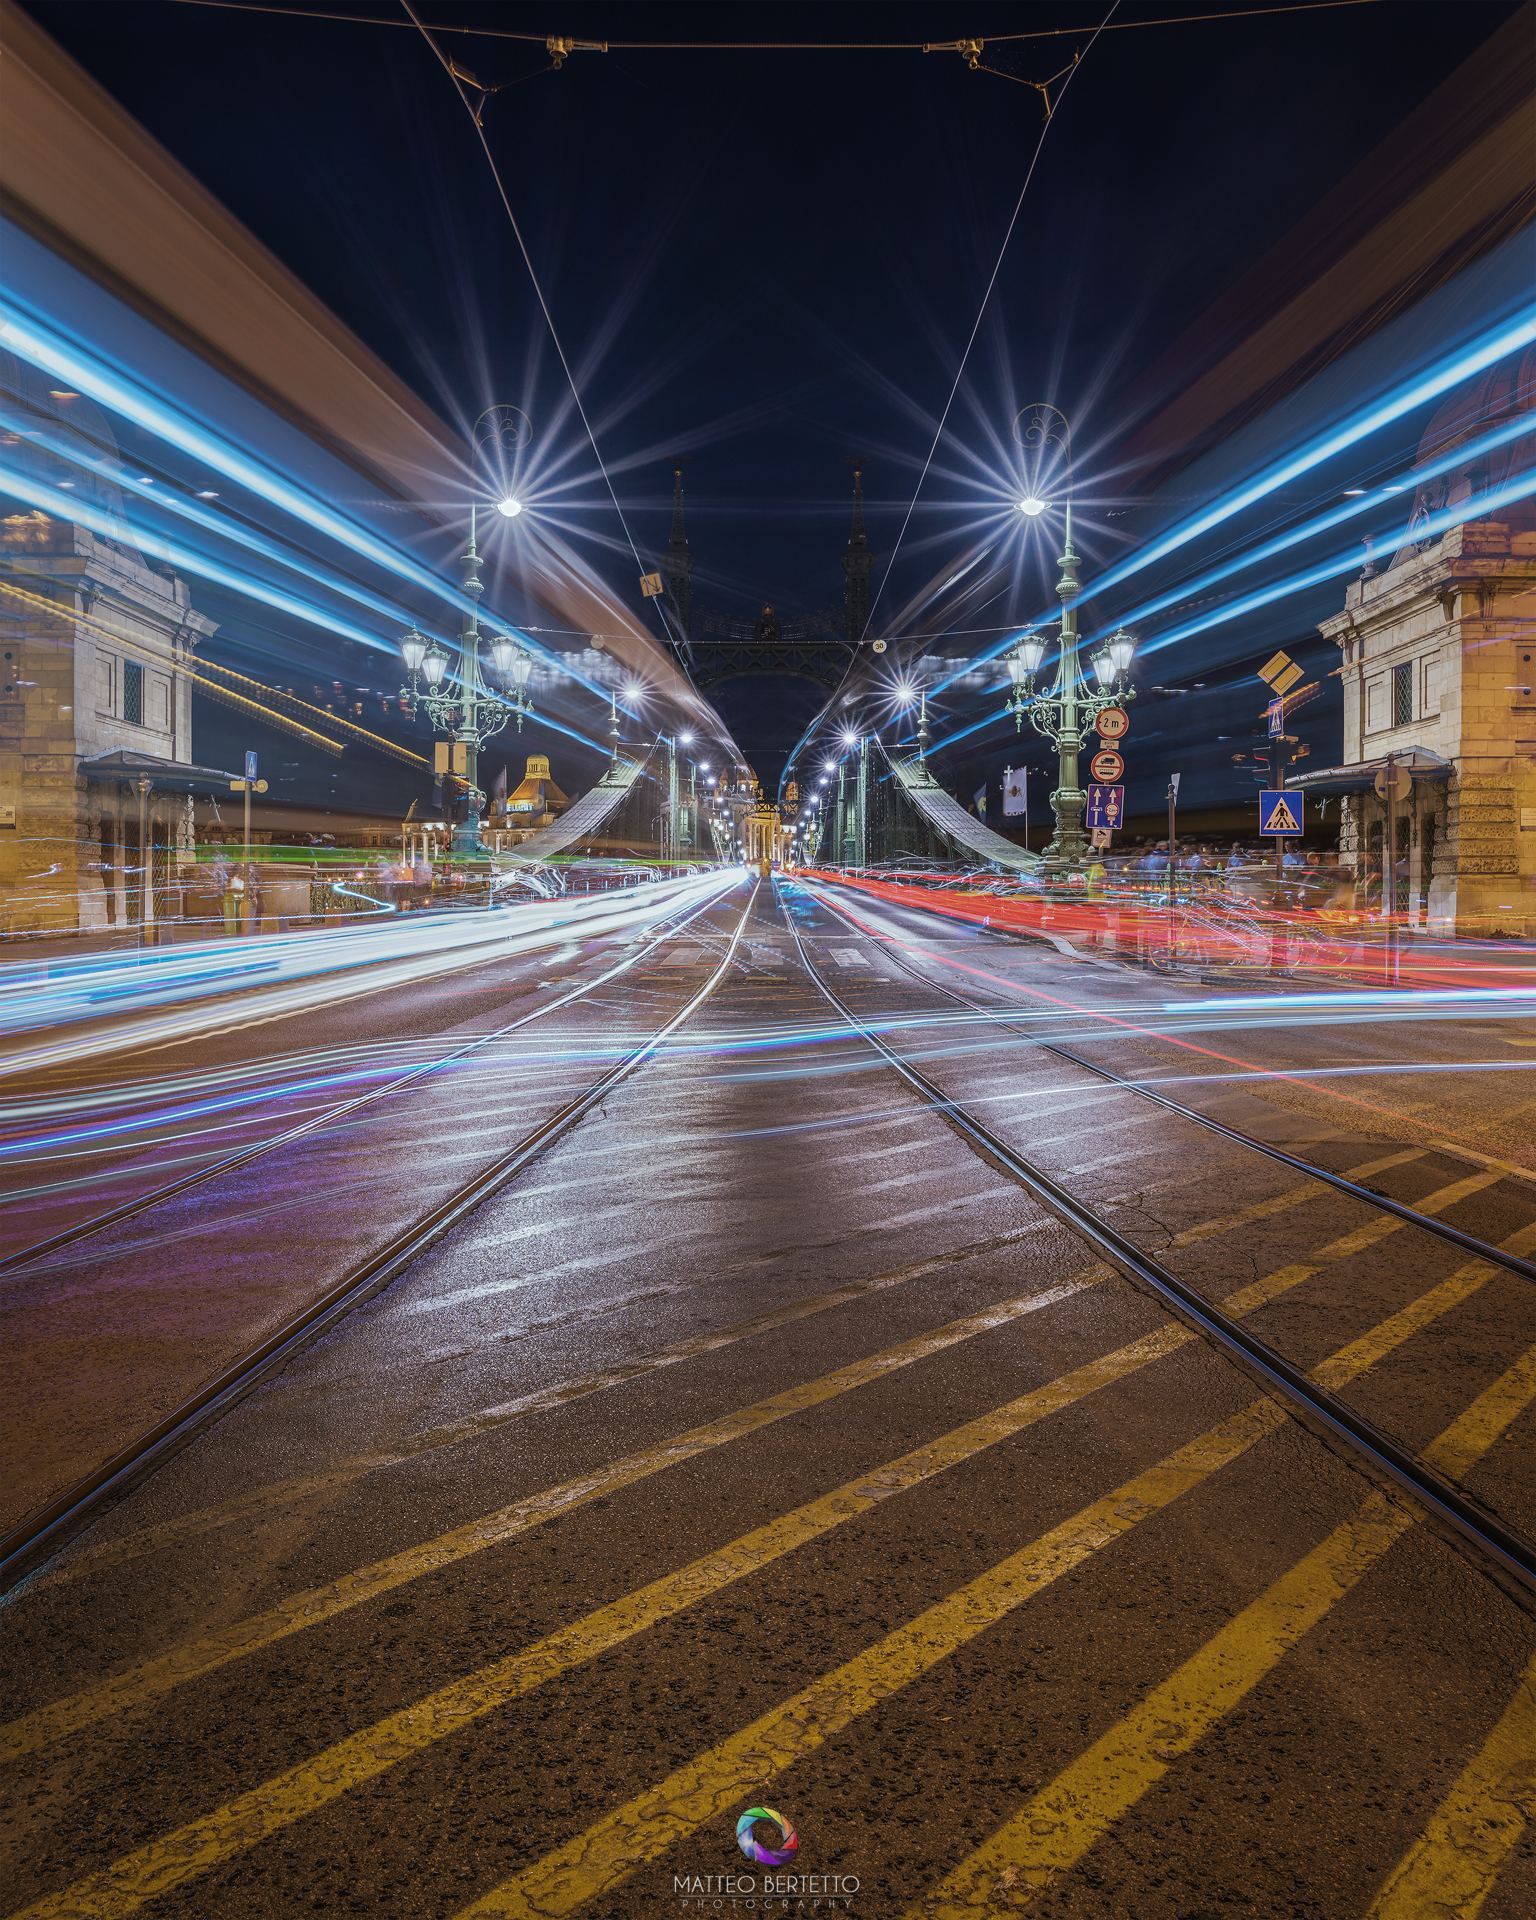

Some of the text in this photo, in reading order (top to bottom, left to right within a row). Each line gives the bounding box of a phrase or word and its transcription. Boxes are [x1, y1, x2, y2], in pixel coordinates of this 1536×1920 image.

[875, 642, 884, 650] 30
[1103, 717, 1119, 728] 2 m
